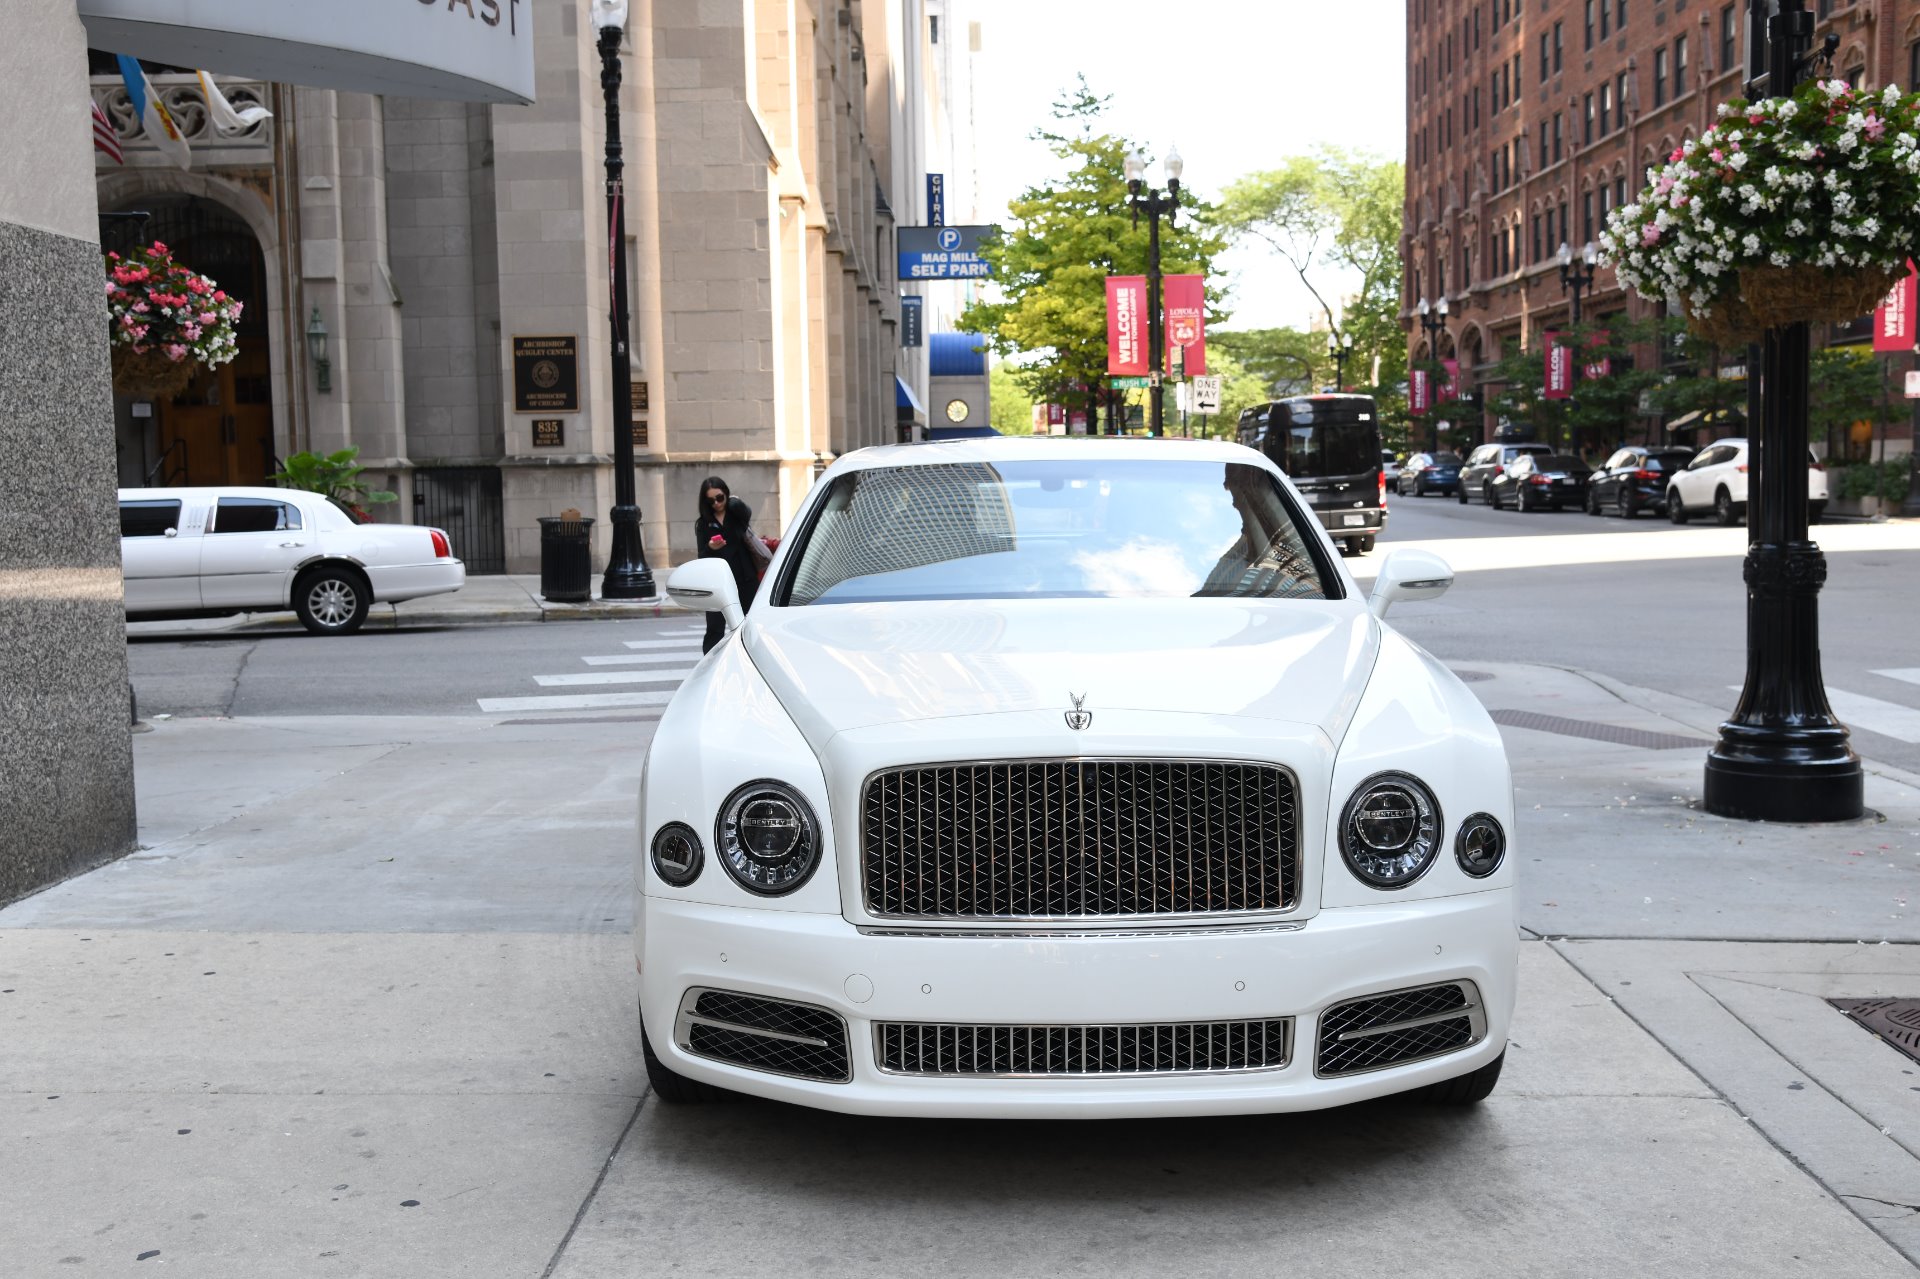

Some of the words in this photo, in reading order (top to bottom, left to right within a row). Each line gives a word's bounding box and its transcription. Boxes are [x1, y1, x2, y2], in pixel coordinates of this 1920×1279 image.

[943, 230, 957, 248] P
[921, 253, 948, 263] MAG
[911, 264, 947, 277] SELF
[950, 263, 989, 276] PARK
[1884, 282, 1898, 337] WELC
[1116, 287, 1131, 365] WELCOME
[522, 340, 567, 348] ARCHBISHOP
[515, 349, 545, 357] QUIGLEY
[546, 348, 574, 356] CENTER
[1119, 378, 1139, 389] RUSH
[1197, 379, 1217, 389] ONE
[1197, 390, 1217, 399] WAY
[537, 421, 559, 433] 835
